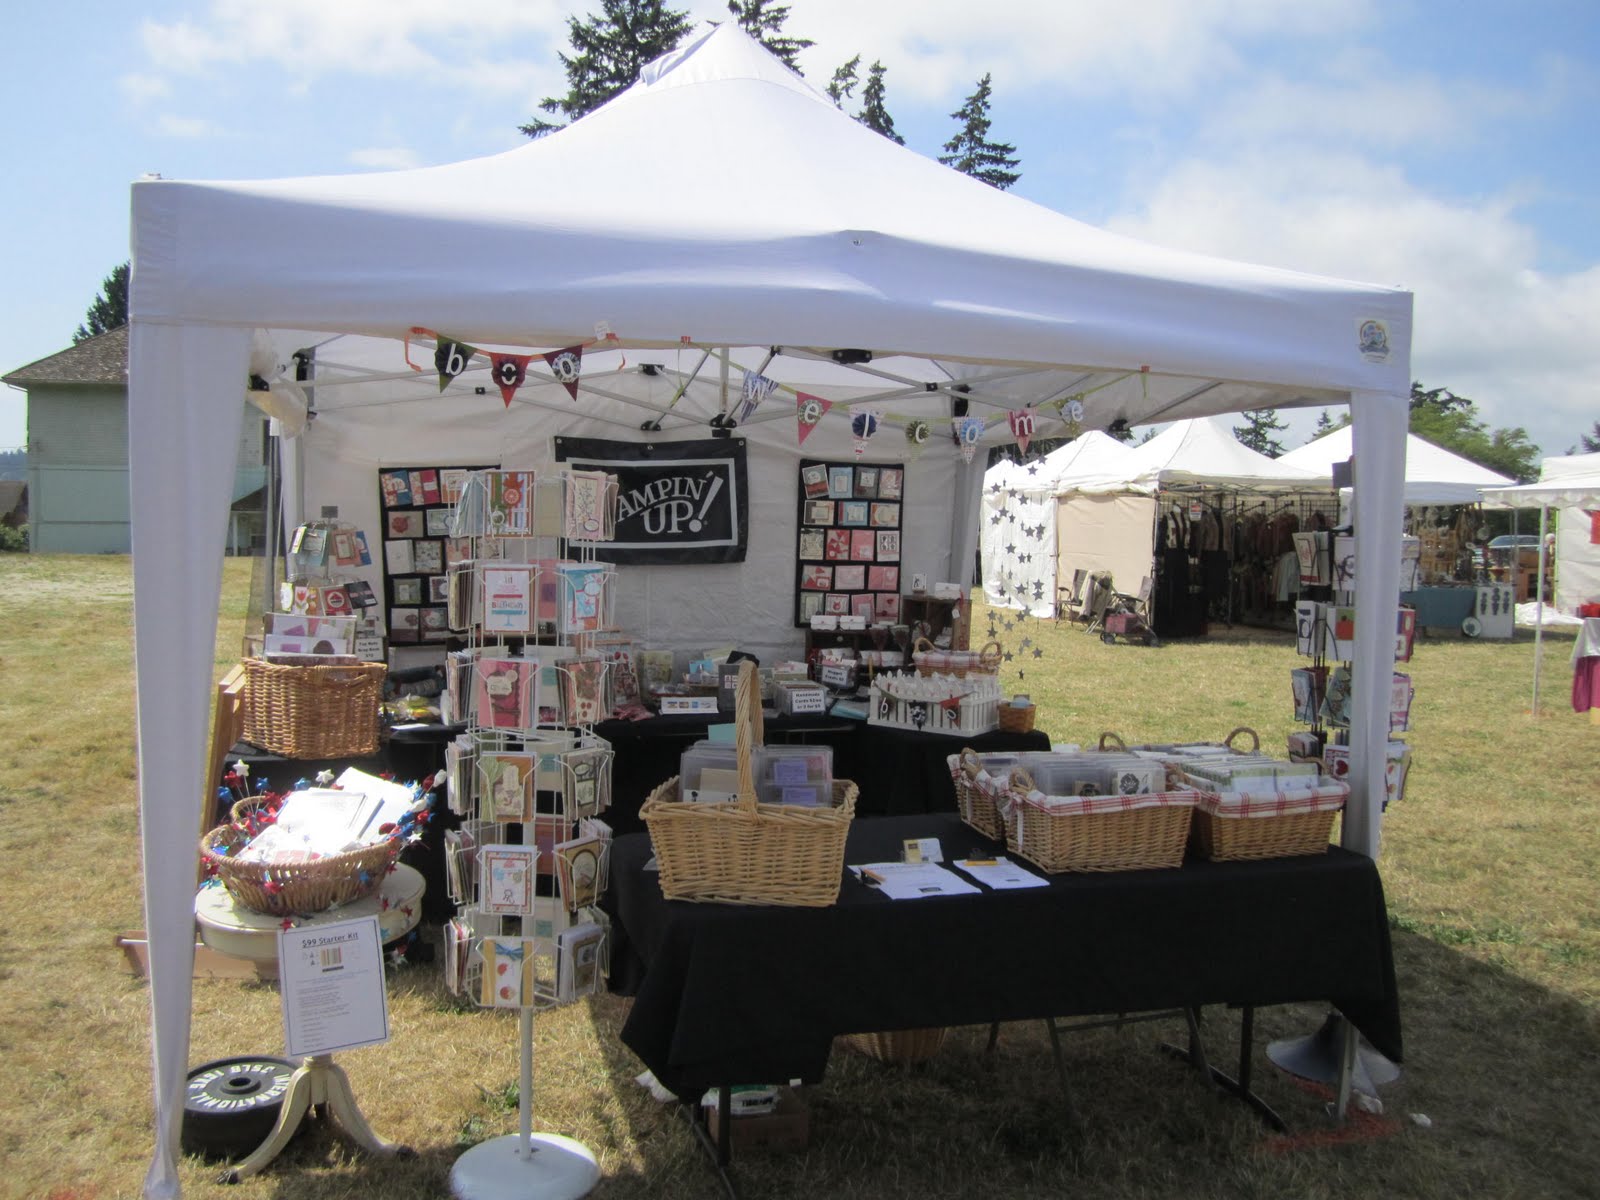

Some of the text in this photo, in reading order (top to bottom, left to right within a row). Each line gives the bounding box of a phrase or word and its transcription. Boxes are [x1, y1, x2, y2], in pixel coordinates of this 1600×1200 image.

[302, 932, 359, 948] $99 Starter Kit
